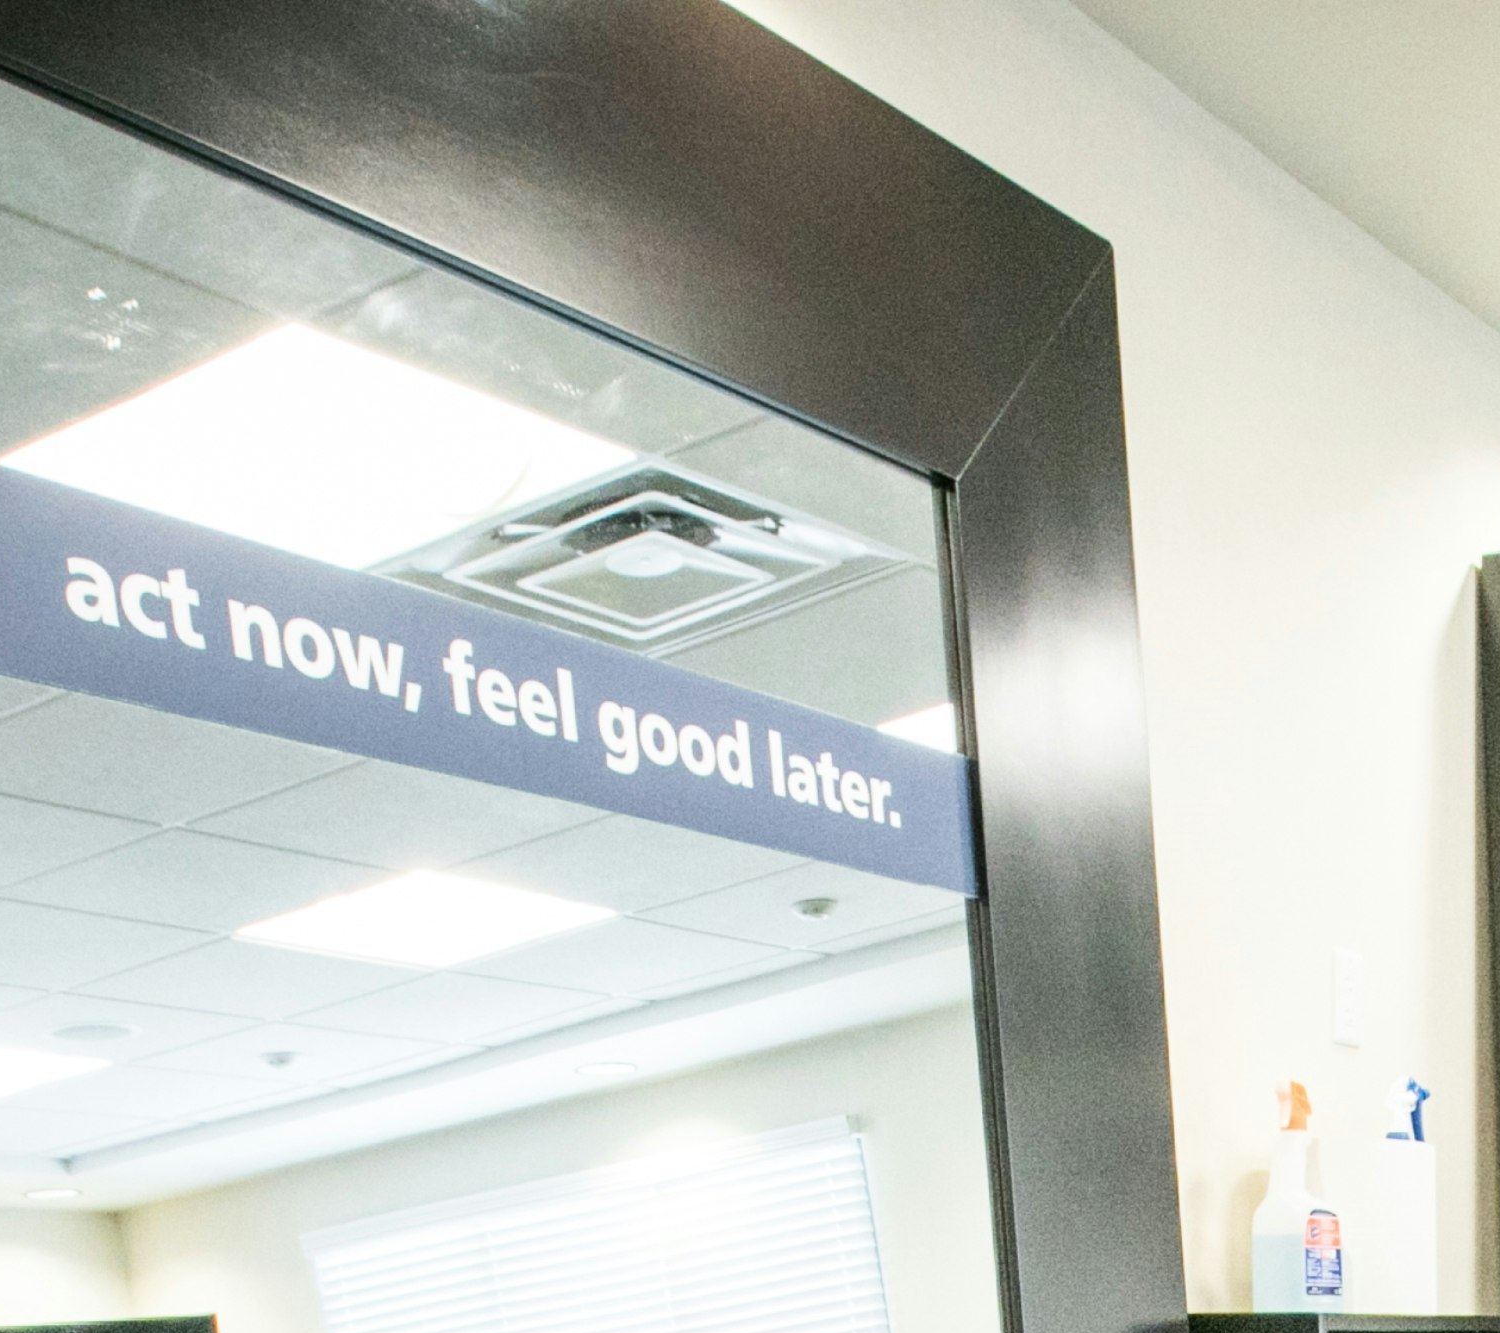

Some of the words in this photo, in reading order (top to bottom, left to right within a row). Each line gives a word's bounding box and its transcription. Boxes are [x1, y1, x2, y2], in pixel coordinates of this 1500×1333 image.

[64, 555, 206, 650] act
[227, 598, 424, 713] now,
[442, 639, 578, 743] feel
[598, 700, 754, 788] good
[769, 730, 902, 828] later.
